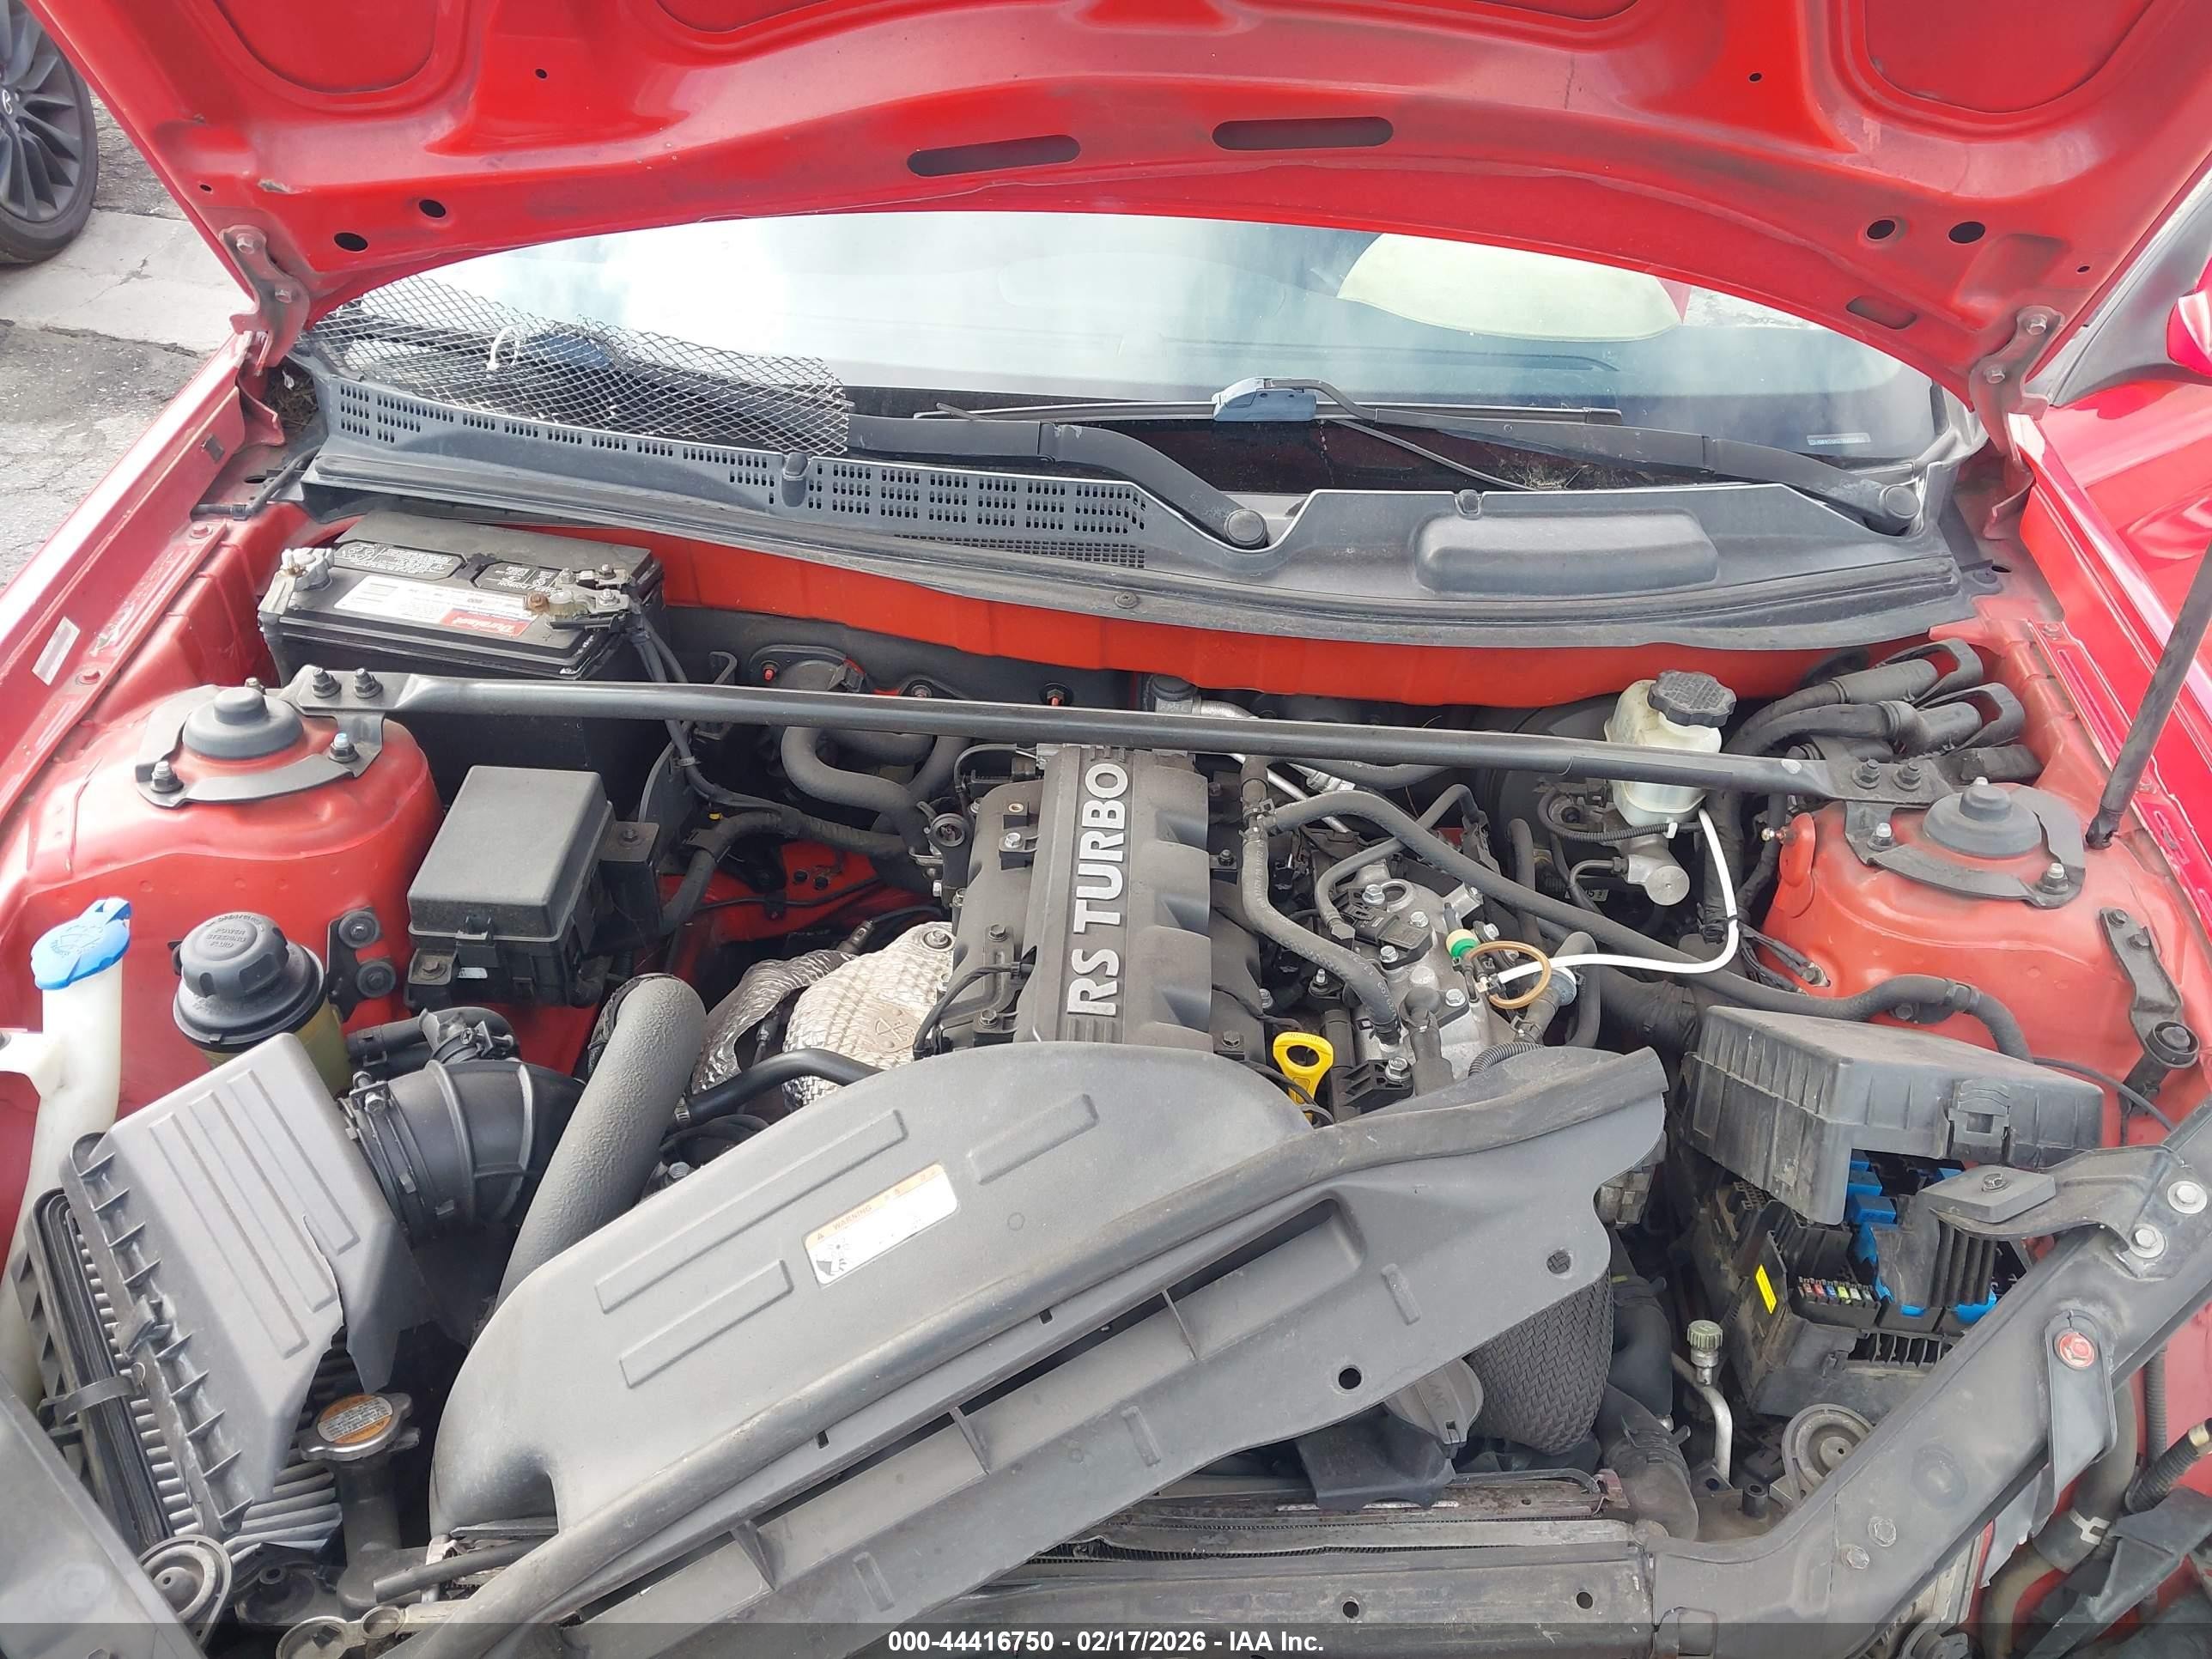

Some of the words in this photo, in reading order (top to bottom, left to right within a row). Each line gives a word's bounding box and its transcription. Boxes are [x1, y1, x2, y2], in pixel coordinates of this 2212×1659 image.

[1073, 763, 1129, 934] TURBO
[1066, 948, 1121, 1017] RS
[832, 1205, 872, 1231] WARNING
